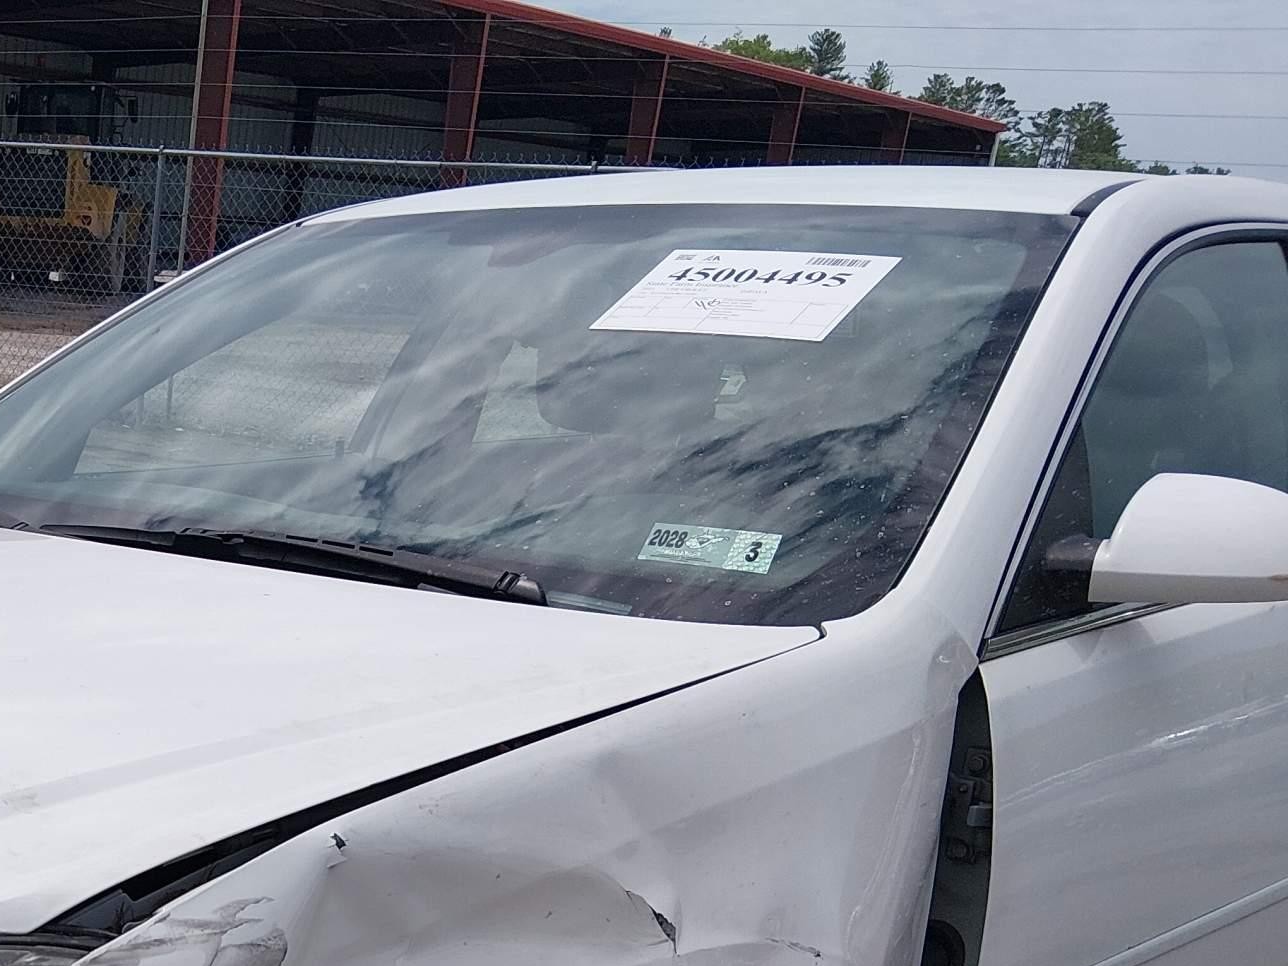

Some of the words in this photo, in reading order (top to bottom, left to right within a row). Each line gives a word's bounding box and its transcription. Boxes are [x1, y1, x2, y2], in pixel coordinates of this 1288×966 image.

[668, 265, 854, 289] 45004495
[648, 529, 689, 549] 2028
[744, 541, 763, 563] 3
